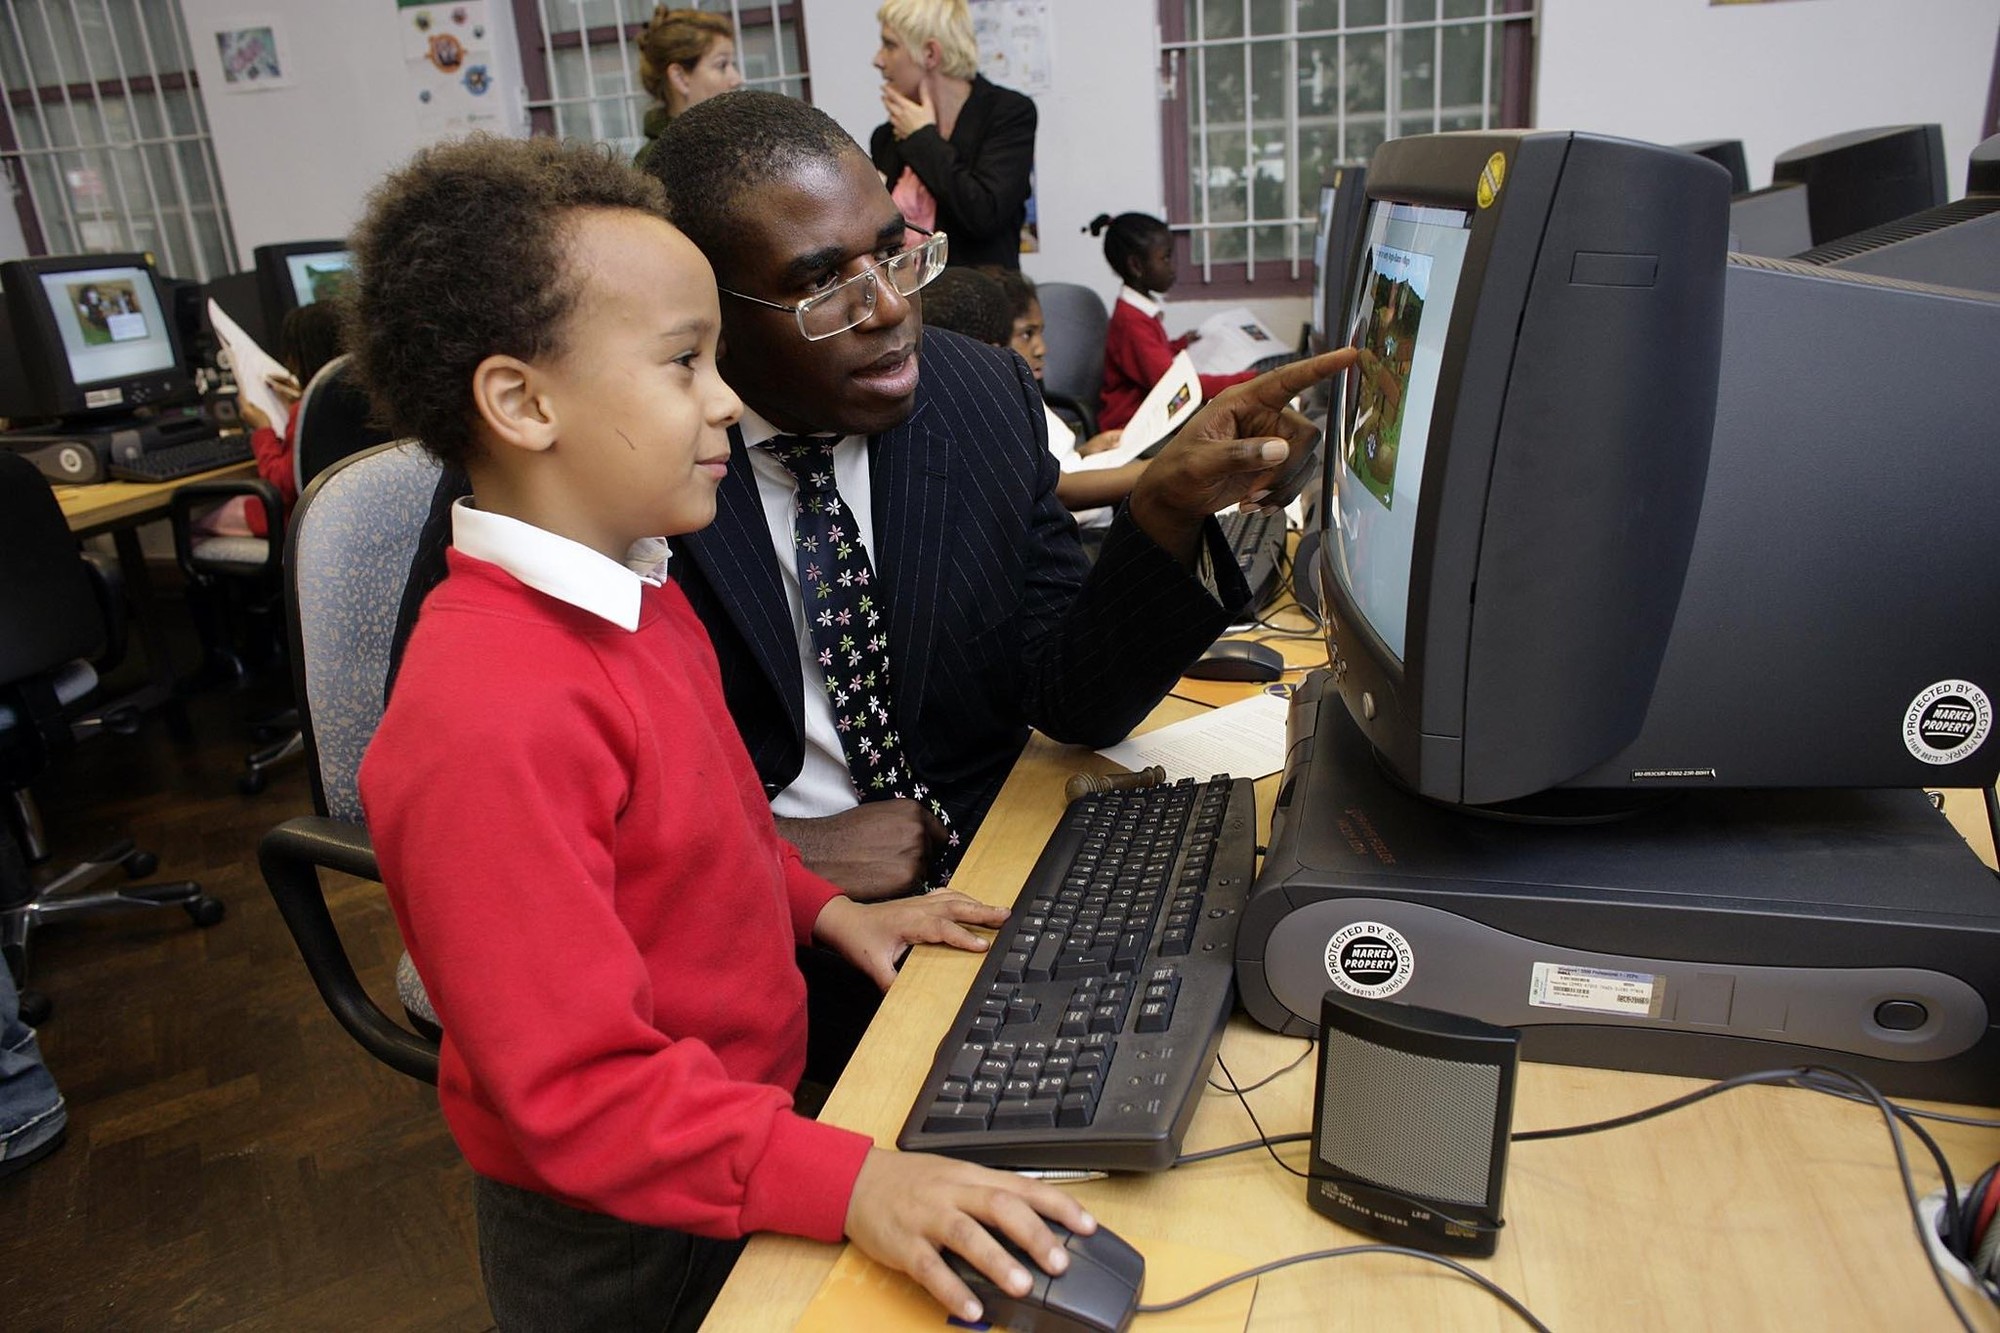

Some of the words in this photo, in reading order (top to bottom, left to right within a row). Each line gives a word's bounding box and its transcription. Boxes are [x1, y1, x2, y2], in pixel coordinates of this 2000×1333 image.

[1907, 684, 1951, 735] PROTECTED
[1956, 684, 1972, 694] BY
[1933, 709, 1974, 721] MARKED
[1922, 720, 1974, 733] PROPERTY
[1328, 926, 1362, 974] PROTECTED
[1367, 926, 1383, 934] BY
[1352, 949, 1393, 958] MARKED
[1345, 959, 1396, 970] PROPERTY
